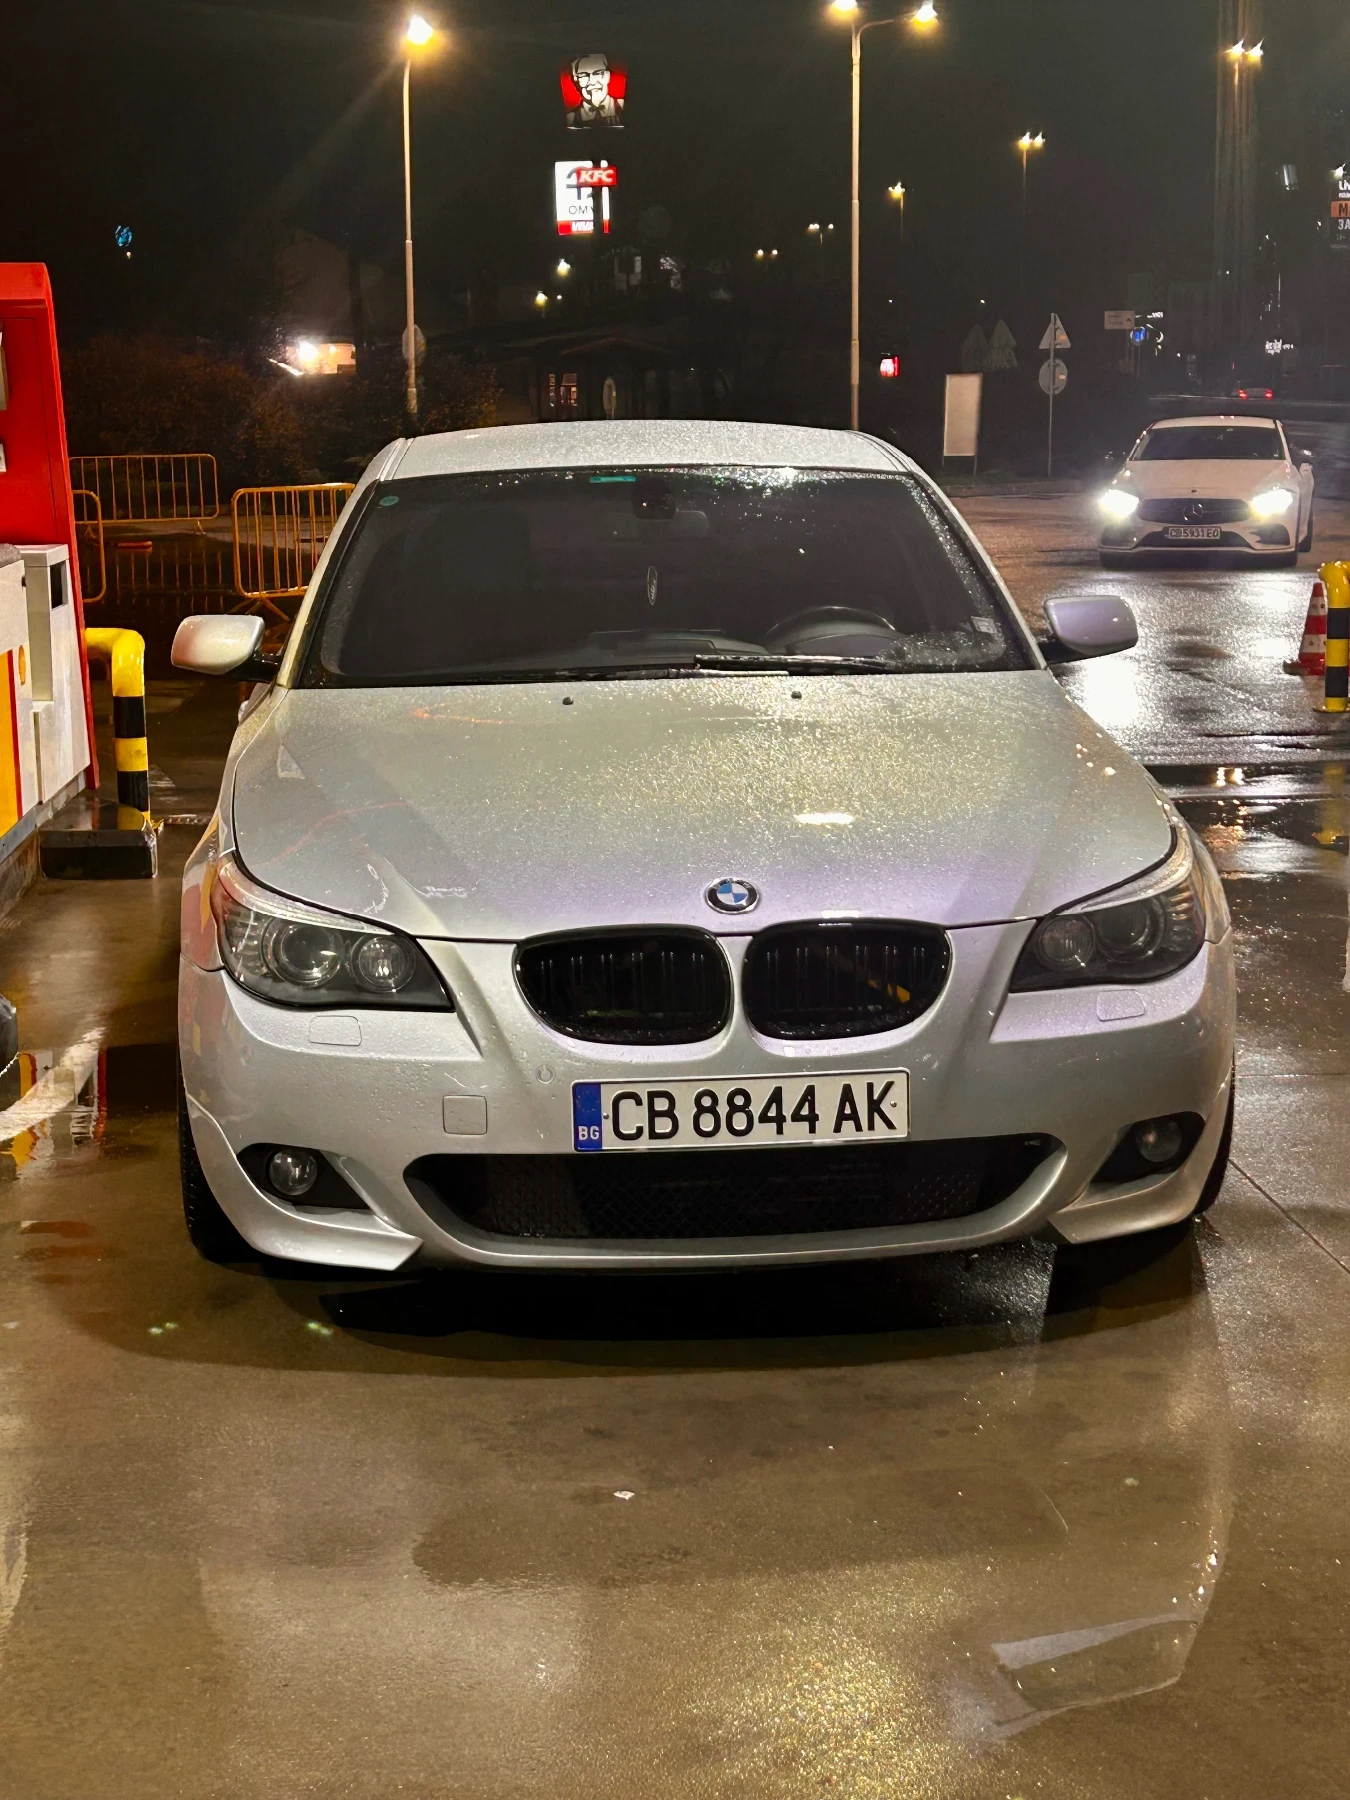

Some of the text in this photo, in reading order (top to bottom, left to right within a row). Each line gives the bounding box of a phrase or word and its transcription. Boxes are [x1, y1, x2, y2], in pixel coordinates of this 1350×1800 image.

[579, 169, 614, 183] KFC
[611, 1080, 898, 1141] CB 8844 AK
[578, 1125, 600, 1141] BG
